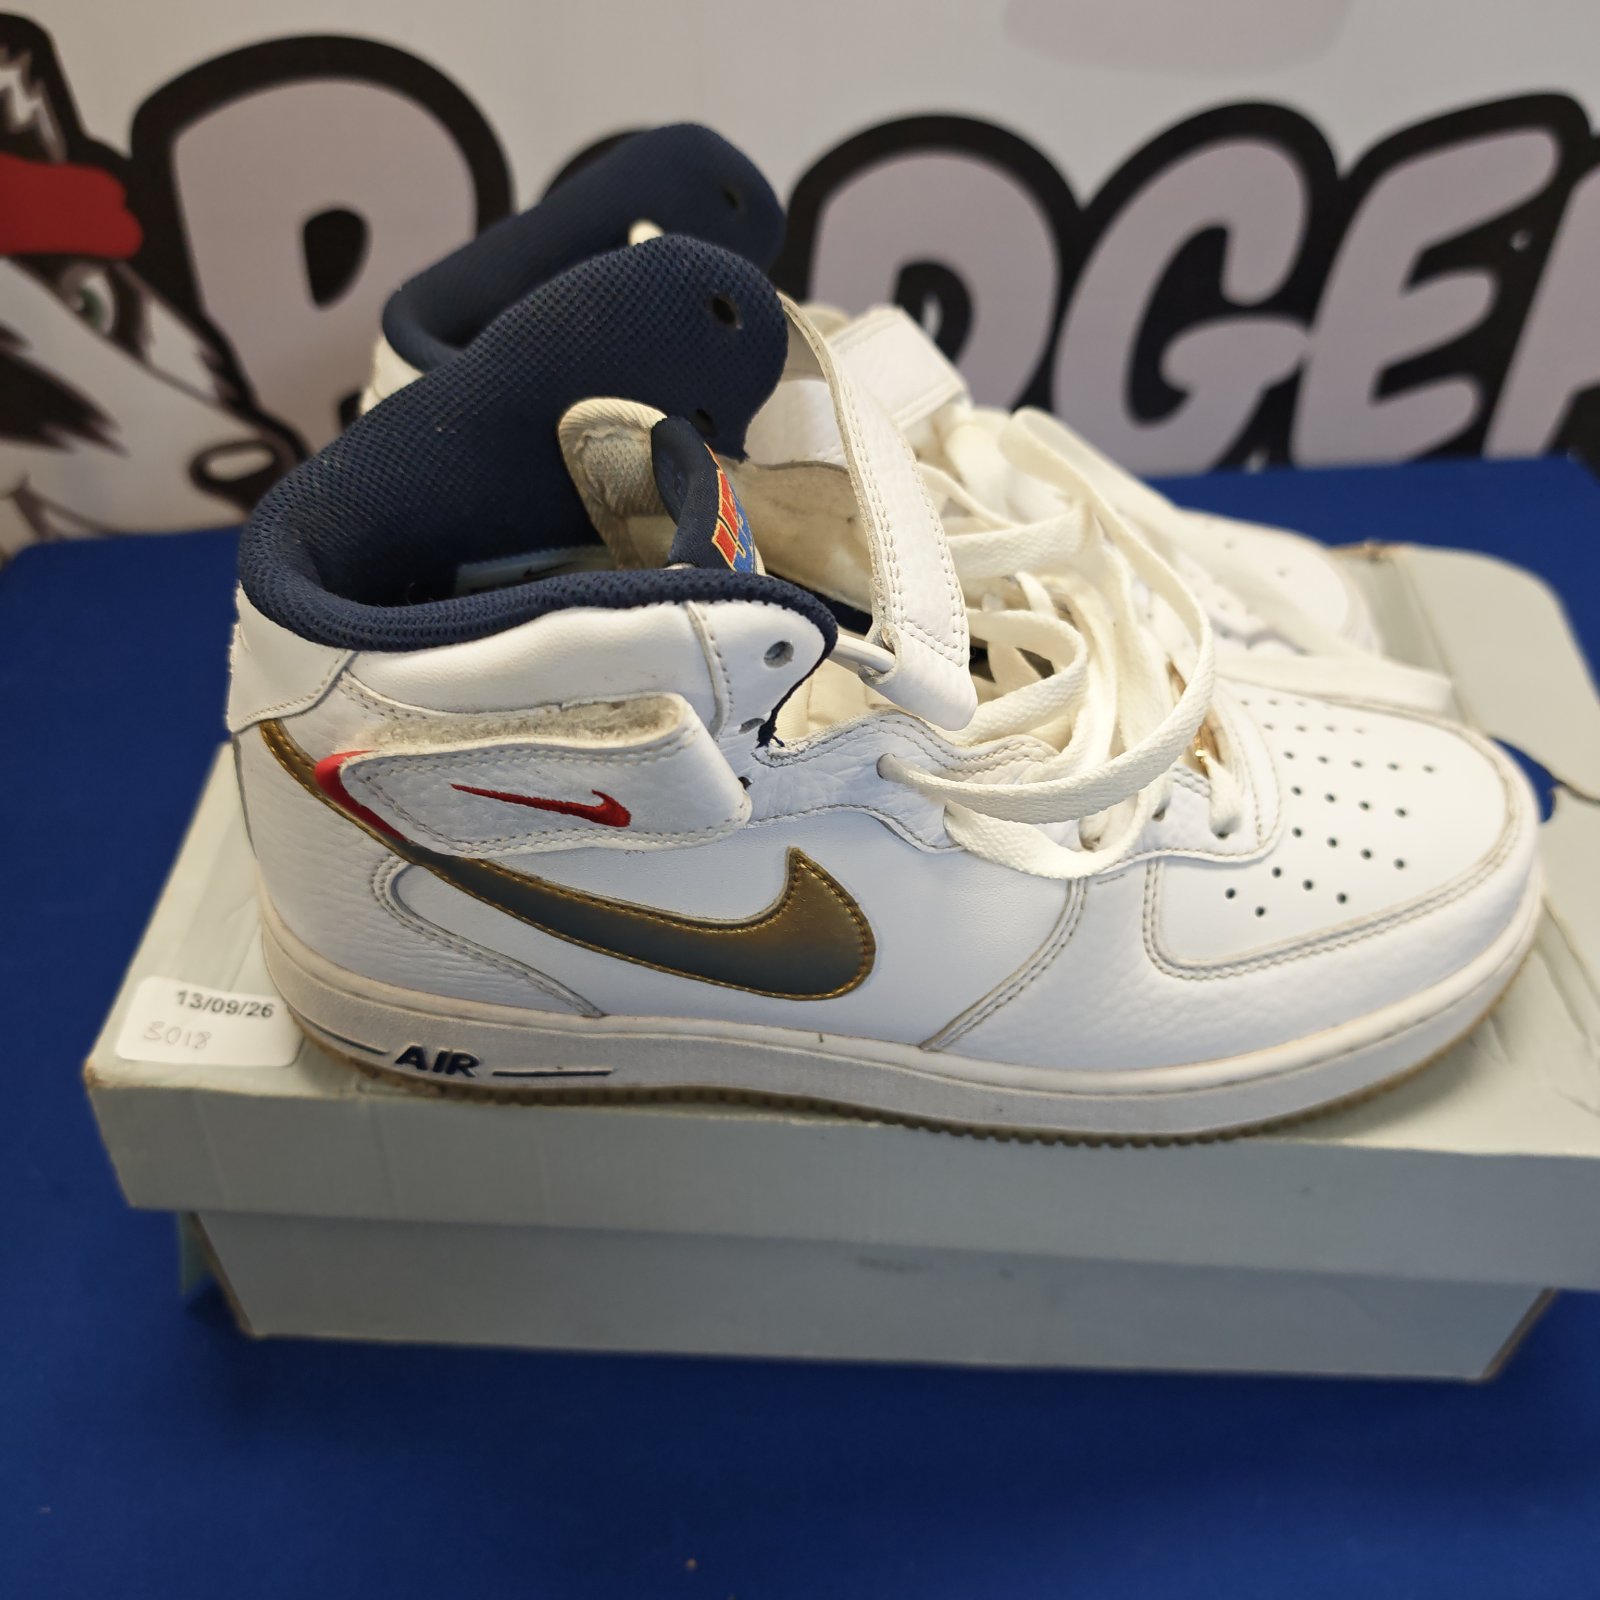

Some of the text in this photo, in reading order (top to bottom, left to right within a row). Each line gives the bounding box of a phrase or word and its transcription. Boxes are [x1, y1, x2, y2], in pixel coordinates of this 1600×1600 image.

[130, 38, 1600, 474] BDGE
[177, 990, 275, 1018] 13/09/26
[395, 1045, 479, 1077] AIR
